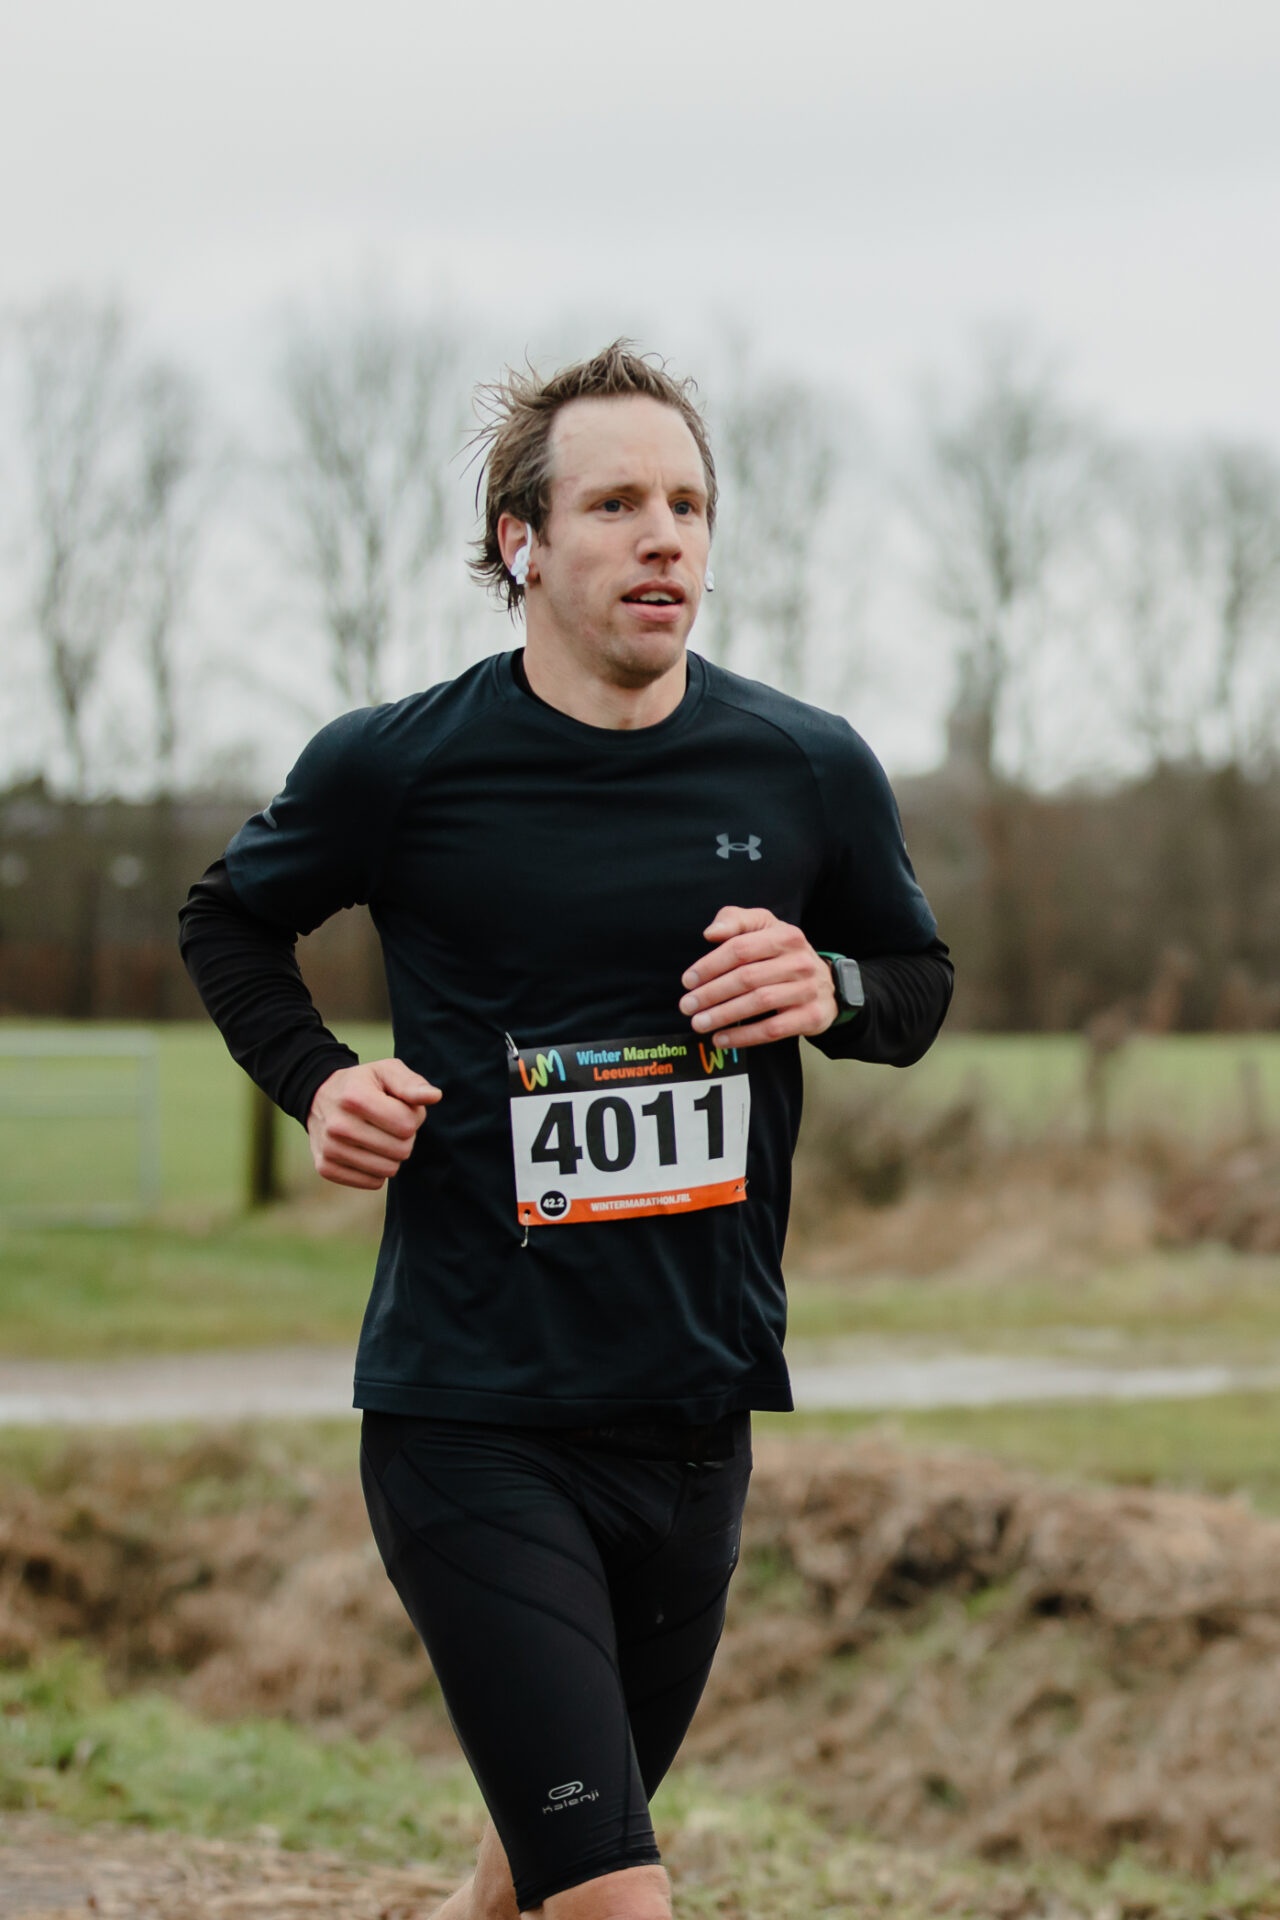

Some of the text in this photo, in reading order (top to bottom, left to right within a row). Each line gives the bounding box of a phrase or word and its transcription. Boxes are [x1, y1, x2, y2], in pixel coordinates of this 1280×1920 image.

[576, 1045, 688, 1066] Winter Marathon
[593, 1061, 674, 1082] Leeuwarden
[530, 1084, 724, 1176] 4011
[542, 1197, 565, 1209] 42.2
